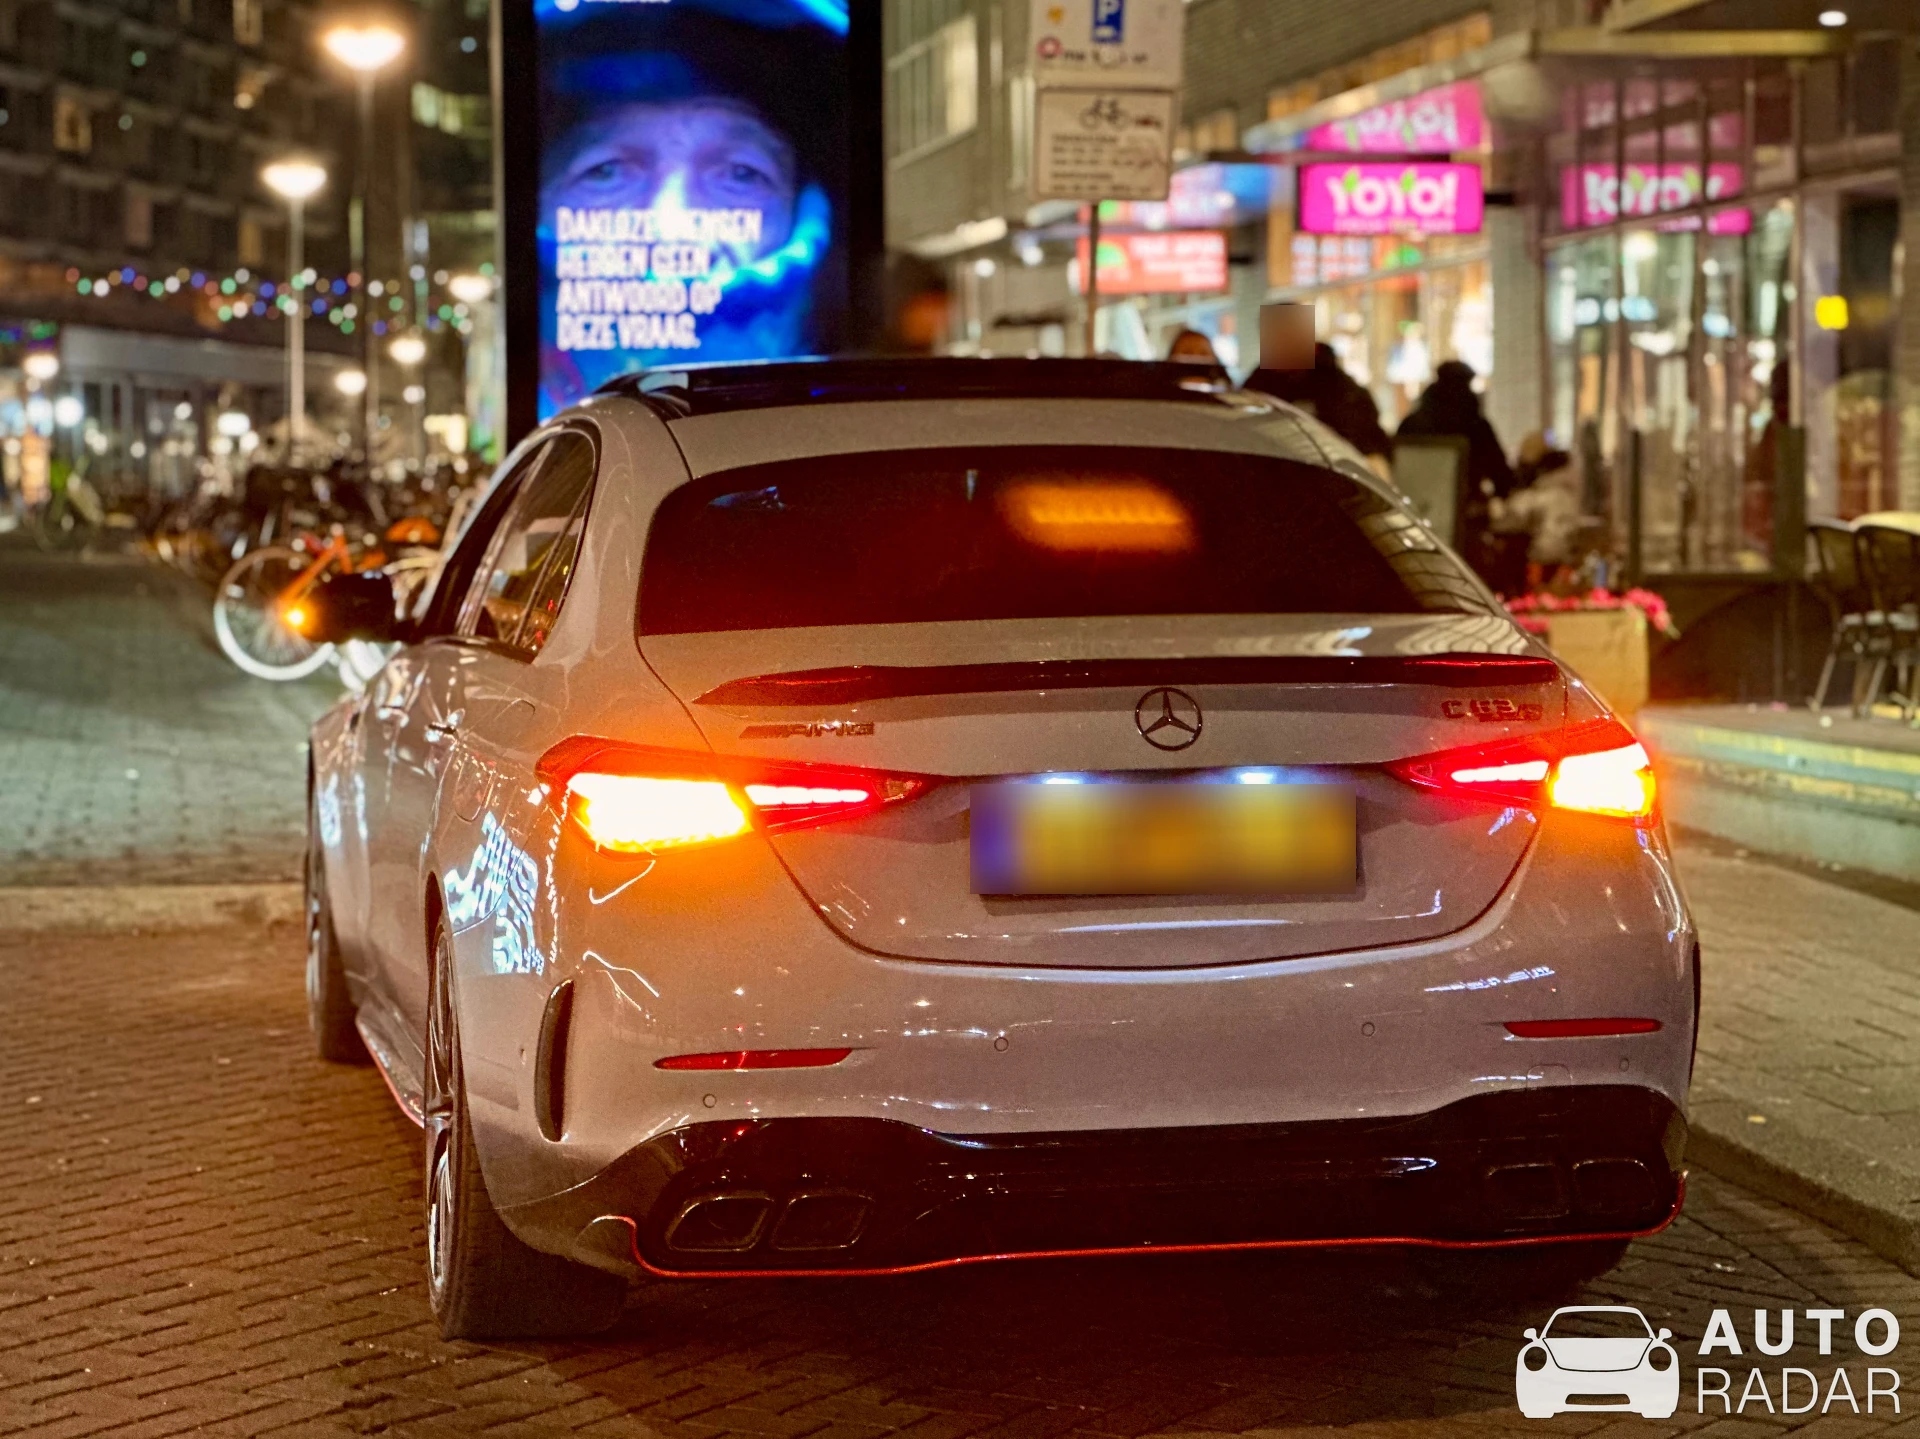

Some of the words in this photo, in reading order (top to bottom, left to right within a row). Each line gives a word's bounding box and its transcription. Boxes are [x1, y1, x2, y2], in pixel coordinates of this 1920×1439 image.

[1326, 167, 1459, 217] YOYO!
[651, 245, 710, 278] GEEN
[556, 281, 687, 313] ANTWOORD
[689, 281, 722, 314] OP
[557, 313, 617, 350] DEZE
[616, 313, 701, 349] VRAAG.
[785, 721, 875, 738] AMG
